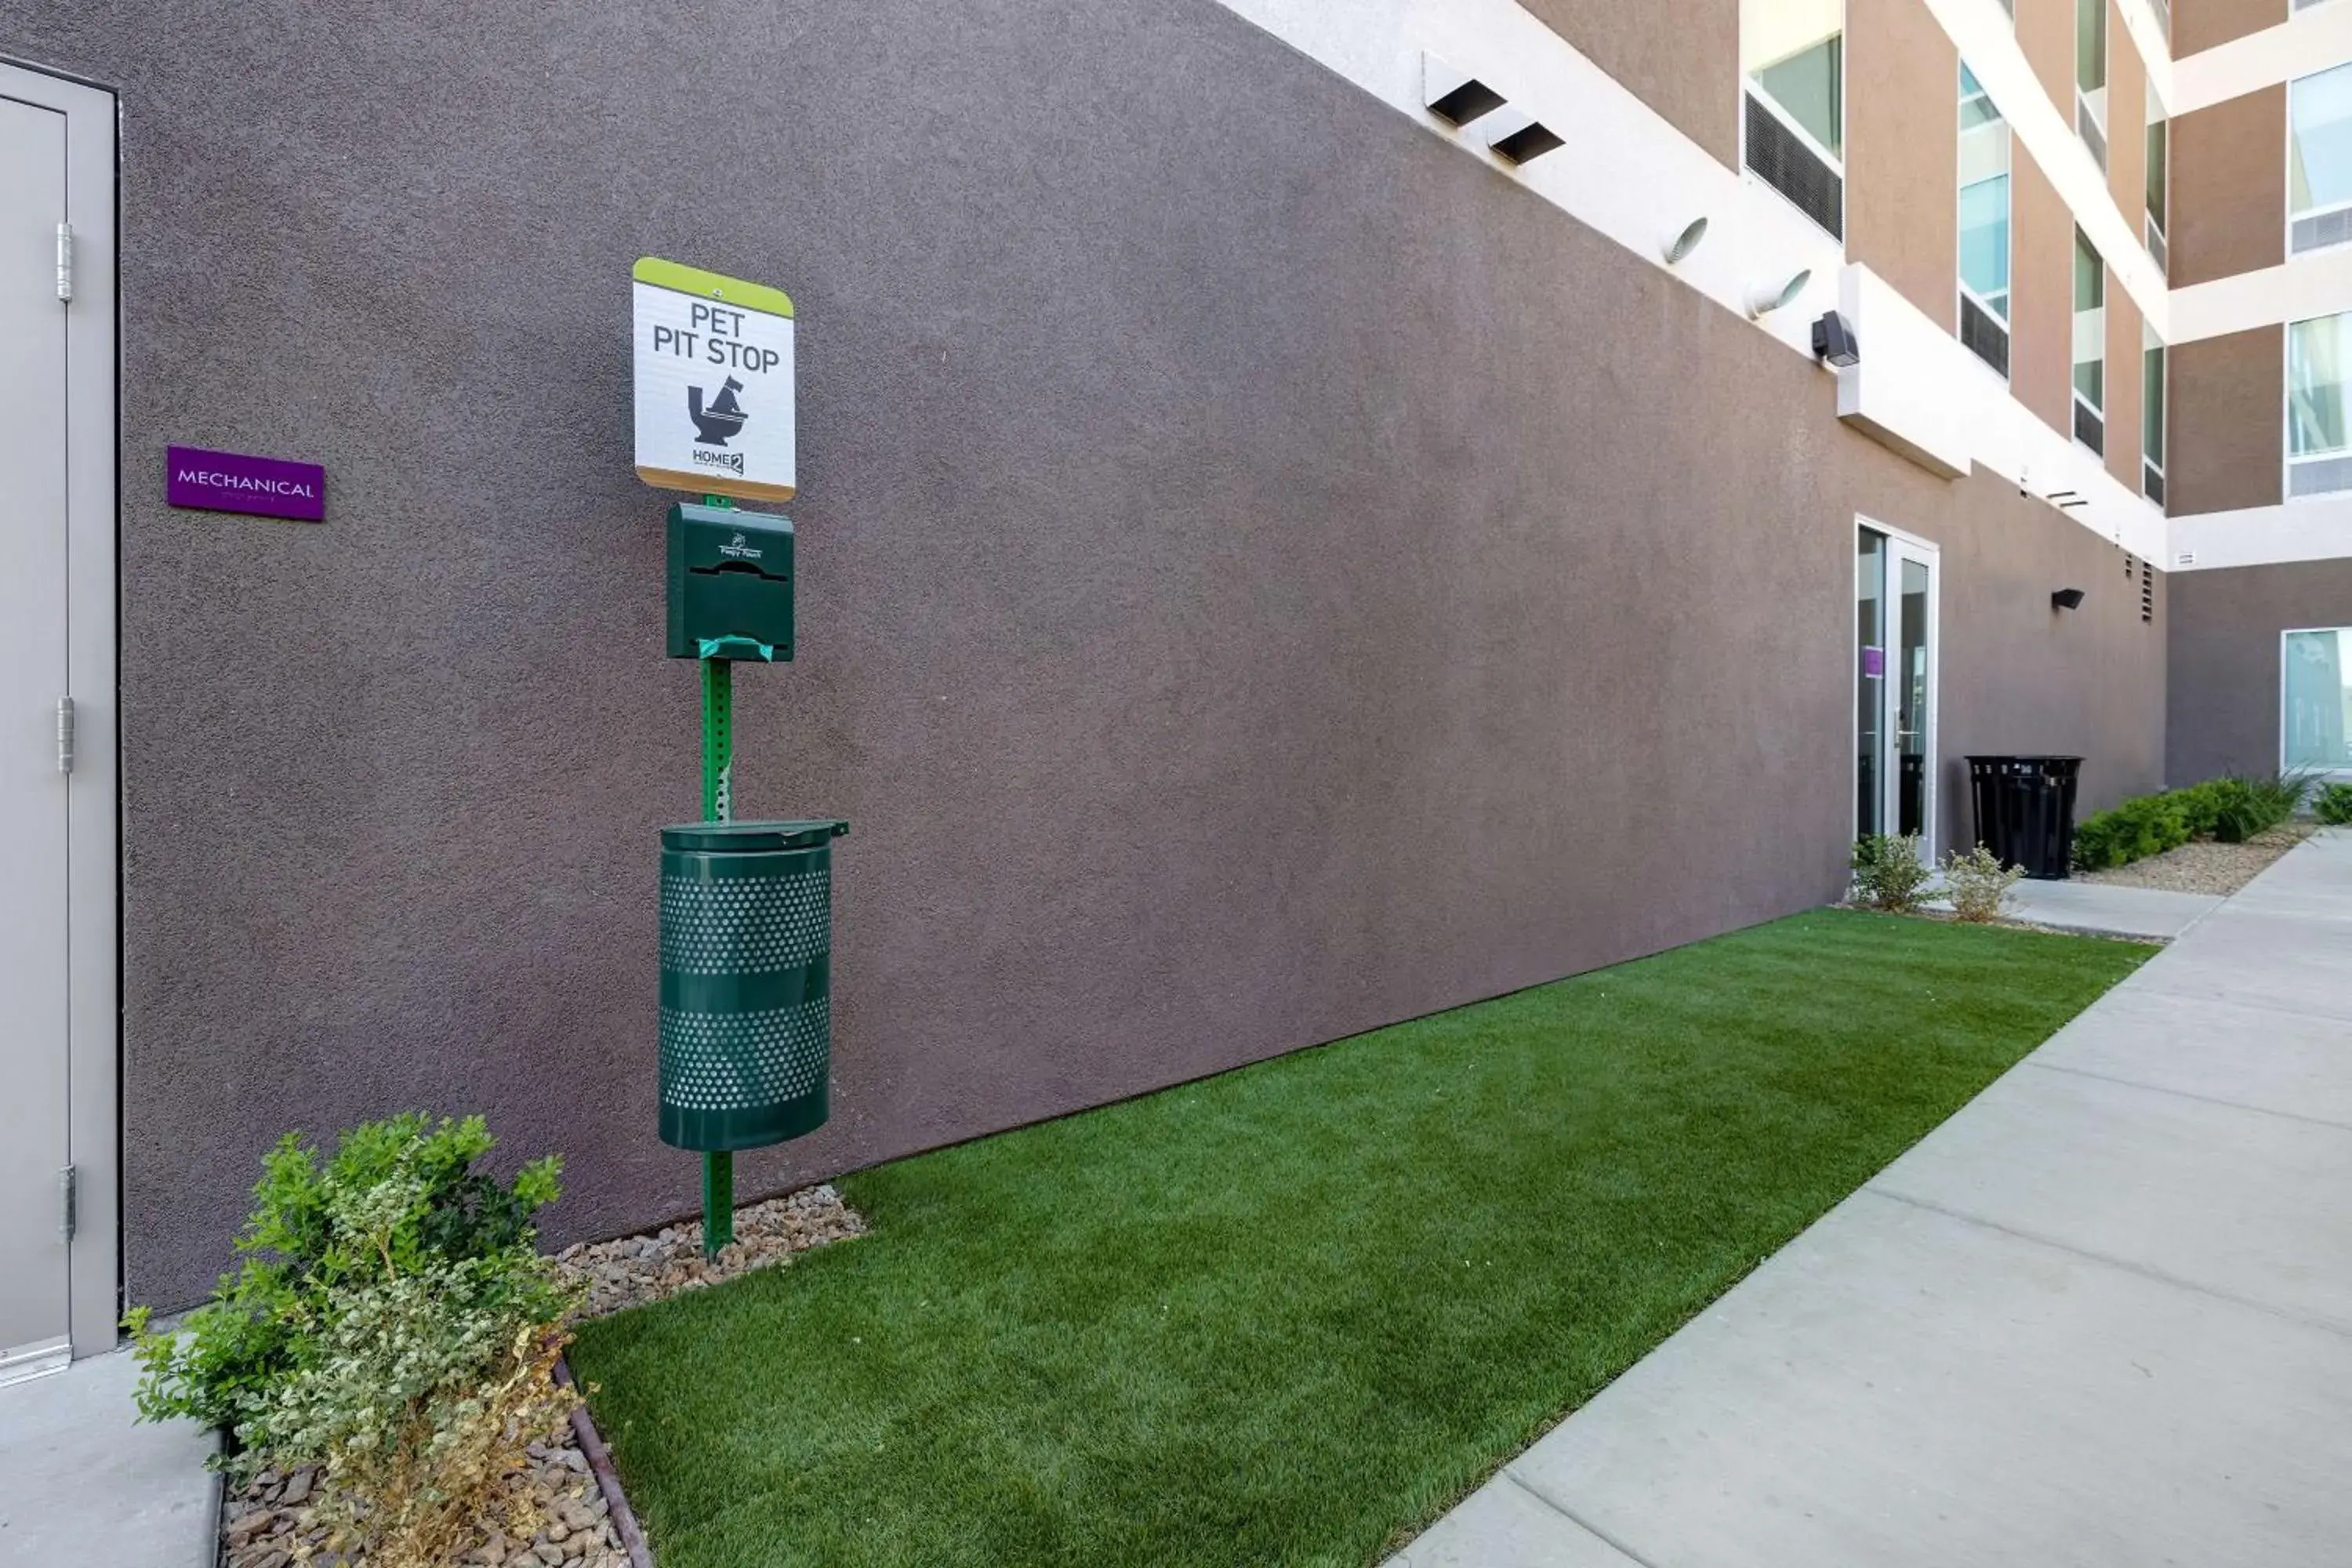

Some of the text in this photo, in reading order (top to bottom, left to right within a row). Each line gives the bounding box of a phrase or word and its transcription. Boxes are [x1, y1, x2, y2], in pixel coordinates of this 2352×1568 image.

[691, 303, 745, 337] PET
[654, 325, 779, 373] PIT STOP
[178, 470, 314, 498] MECHANICAL
